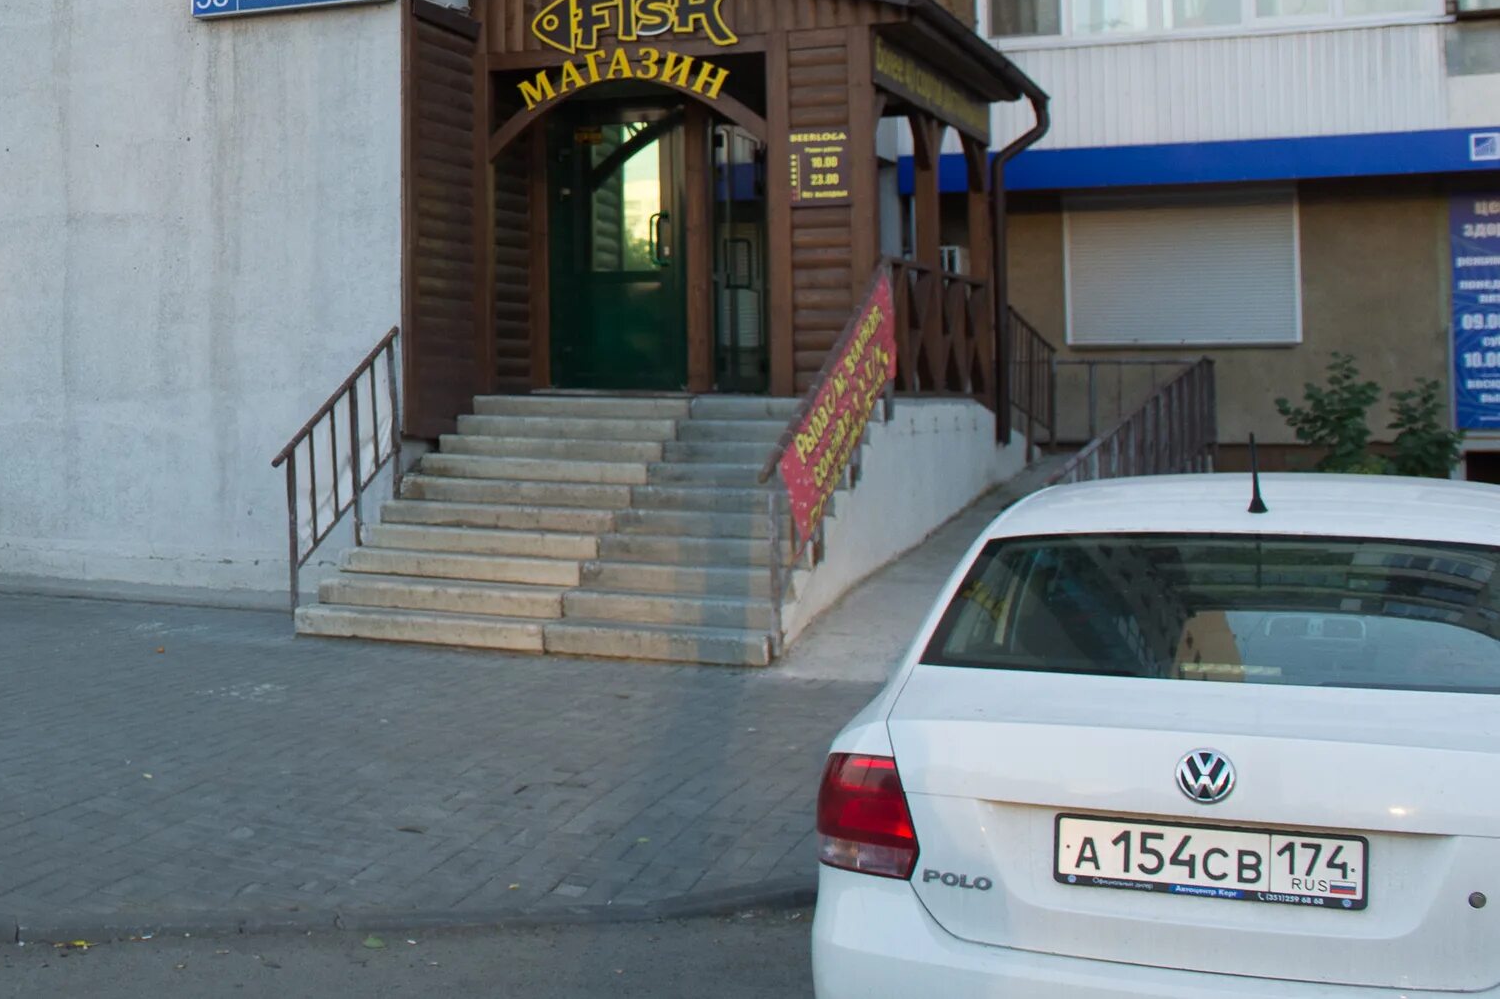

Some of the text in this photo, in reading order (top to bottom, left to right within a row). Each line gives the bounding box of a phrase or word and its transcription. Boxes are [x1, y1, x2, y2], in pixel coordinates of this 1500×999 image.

[516, 47, 730, 112] МАГАЗИН
[1276, 841, 1350, 880] 174
[922, 868, 993, 891] POLO
[1175, 885, 1217, 896] Автоцентр
[1291, 878, 1328, 893] RUS
